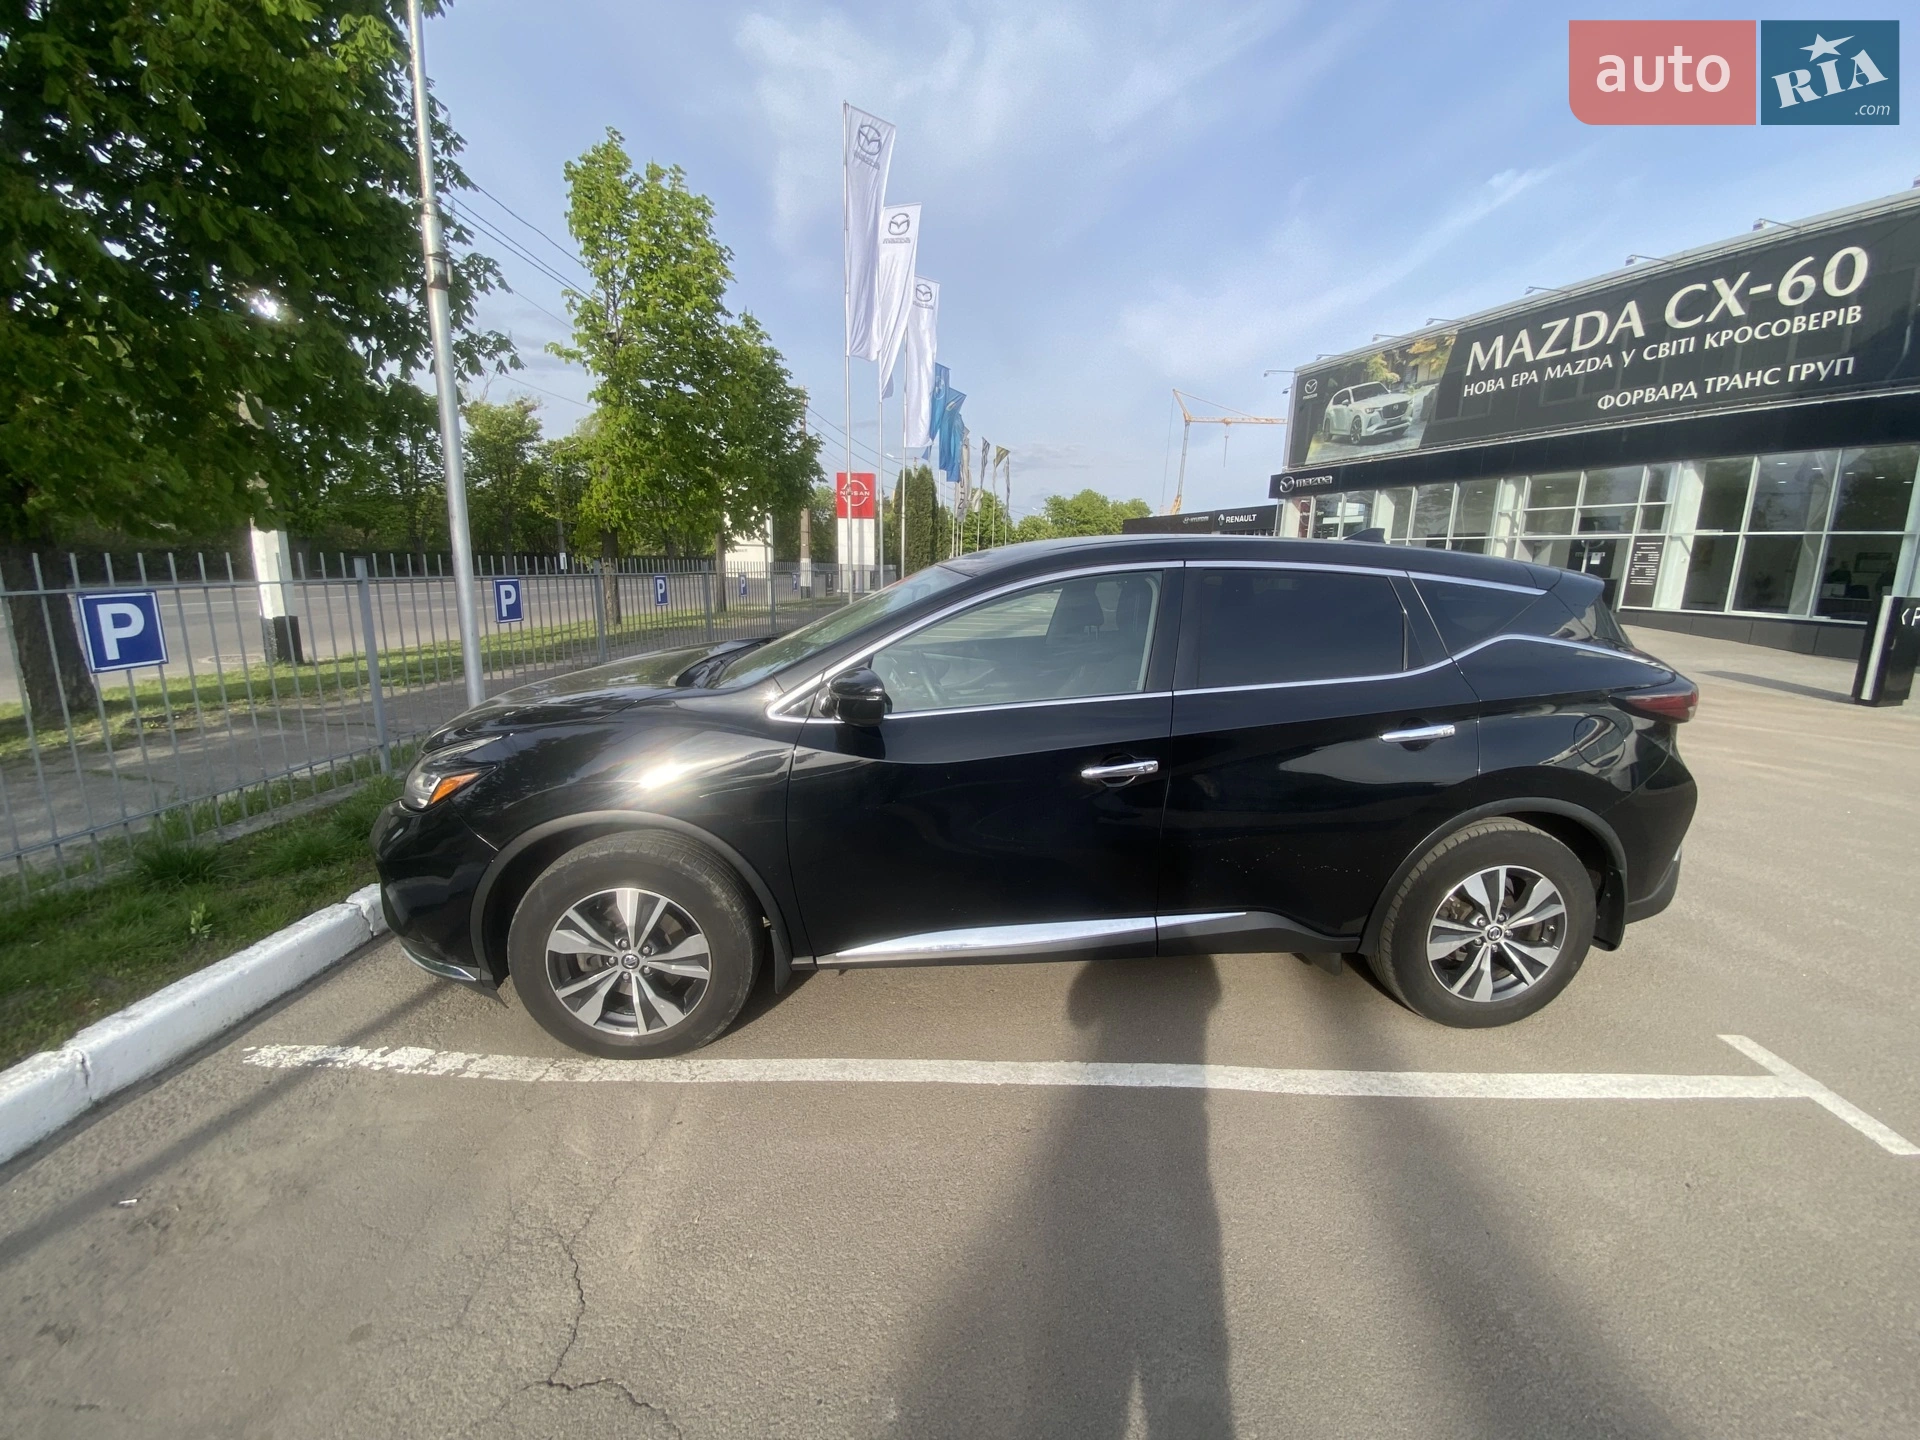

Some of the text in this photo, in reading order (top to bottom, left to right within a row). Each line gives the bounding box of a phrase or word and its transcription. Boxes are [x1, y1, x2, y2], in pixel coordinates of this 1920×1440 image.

[1465, 246, 1869, 376] MAZDA CX-60
[1463, 305, 1862, 397] НОВА ЕРА MAZDA У СВІТІ КРОСОВЕРІВ
[1597, 357, 1855, 411] ФОРВАРД ТРАНС ГРУП
[1296, 475, 1333, 487] mazda
[1225, 514, 1257, 523] RENAULT
[500, 584, 516, 617] P
[656, 579, 666, 602] P
[97, 603, 145, 660] P
